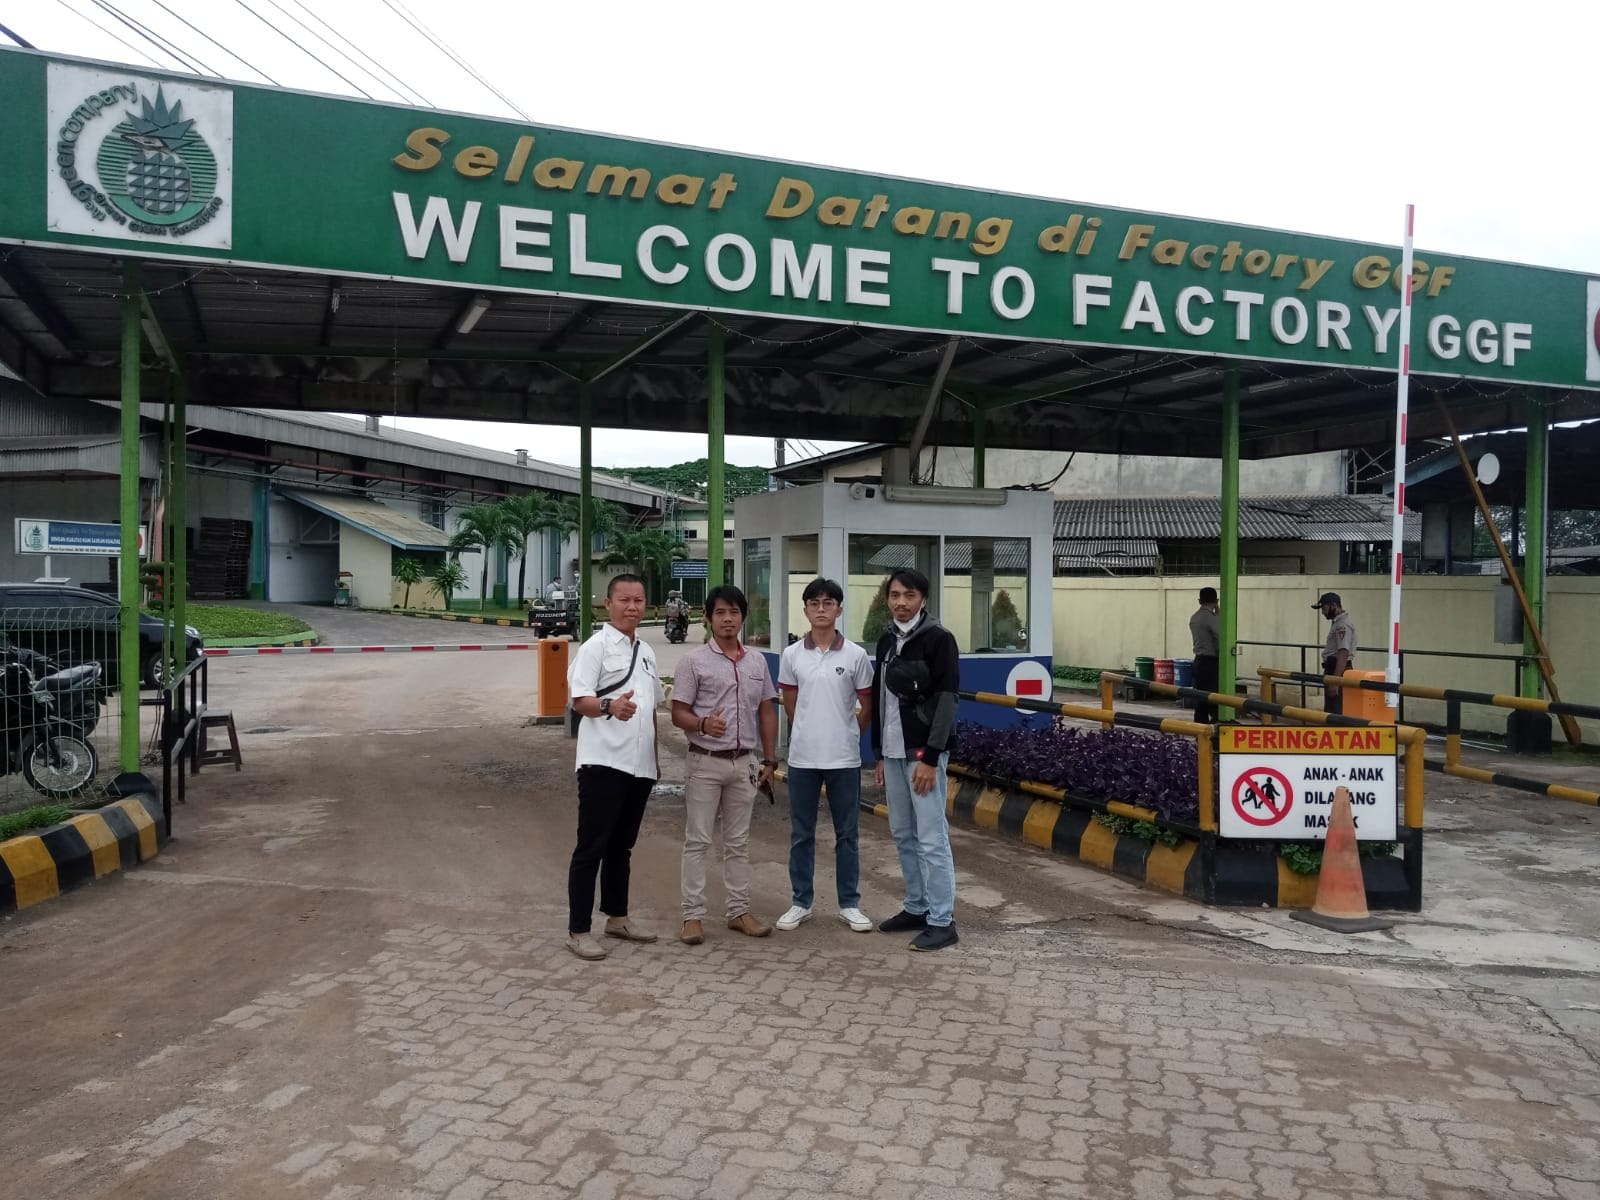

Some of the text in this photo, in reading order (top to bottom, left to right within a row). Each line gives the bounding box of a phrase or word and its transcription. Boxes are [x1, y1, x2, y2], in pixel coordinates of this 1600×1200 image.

[394, 128, 1456, 298] Selamat Datang di Factory GGF
[393, 192, 1533, 367] WELCOME TO FACTORY GGF
[1233, 729, 1381, 750] PERINGATAN
[1303, 767, 1339, 781] ANAK
[1348, 767, 1385, 781] ANAK
[1304, 791, 1376, 805] DILAANG
